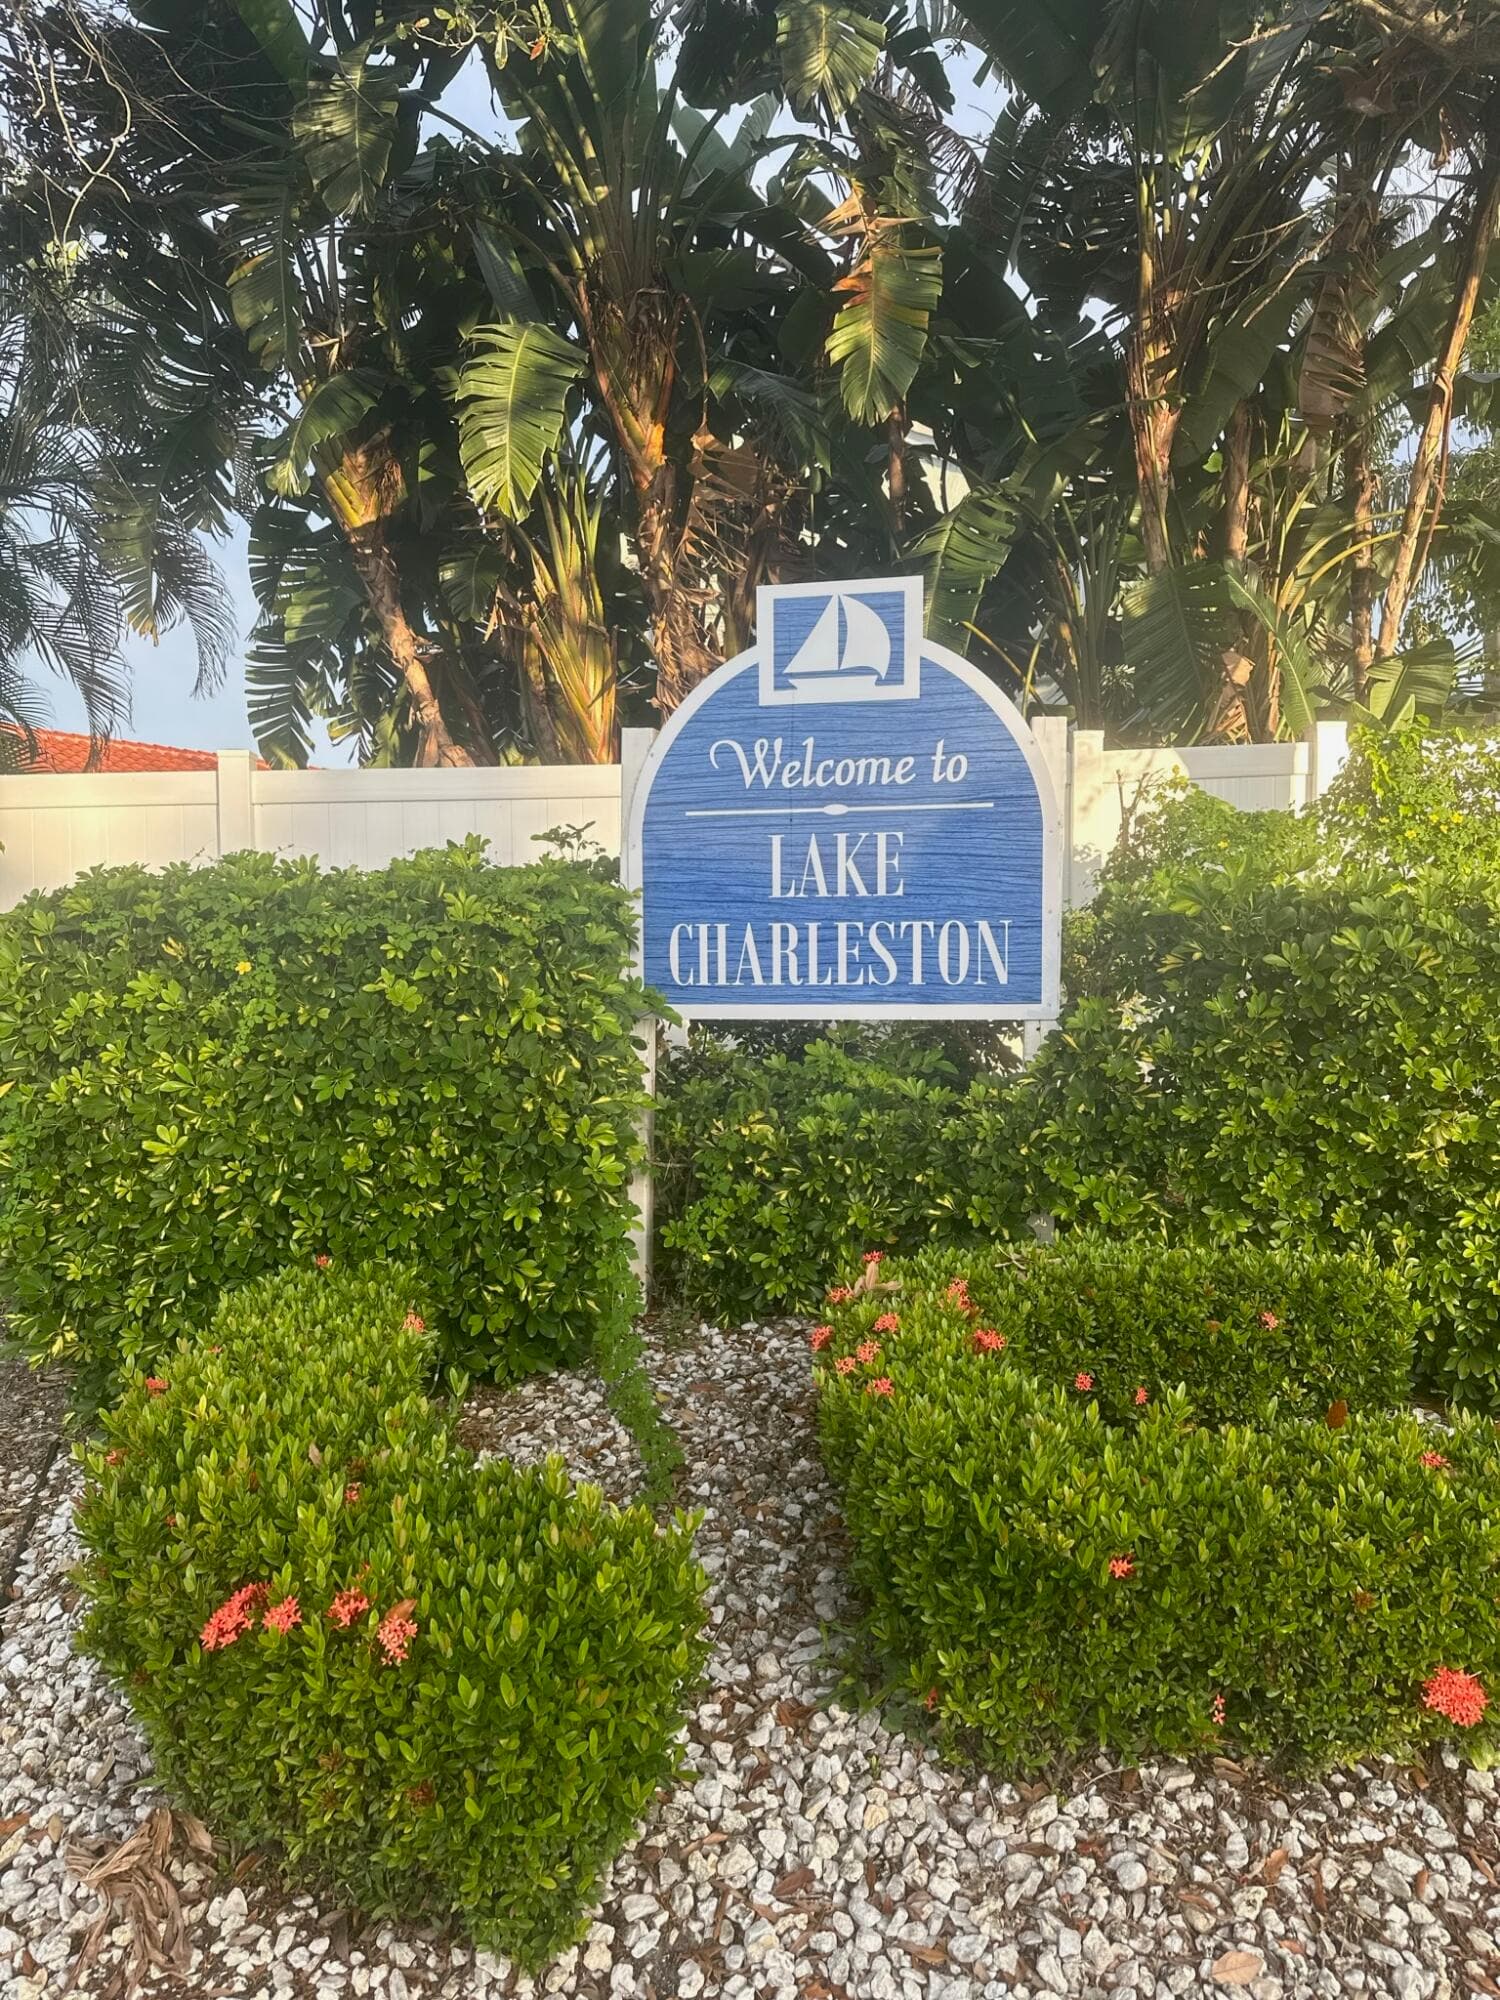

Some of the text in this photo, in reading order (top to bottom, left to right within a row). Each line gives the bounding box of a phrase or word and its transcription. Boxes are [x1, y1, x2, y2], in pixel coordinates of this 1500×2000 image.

[709, 737, 969, 790] Welcome to
[767, 831, 904, 899] LAKE
[669, 919, 1012, 987] CHARLESTON
